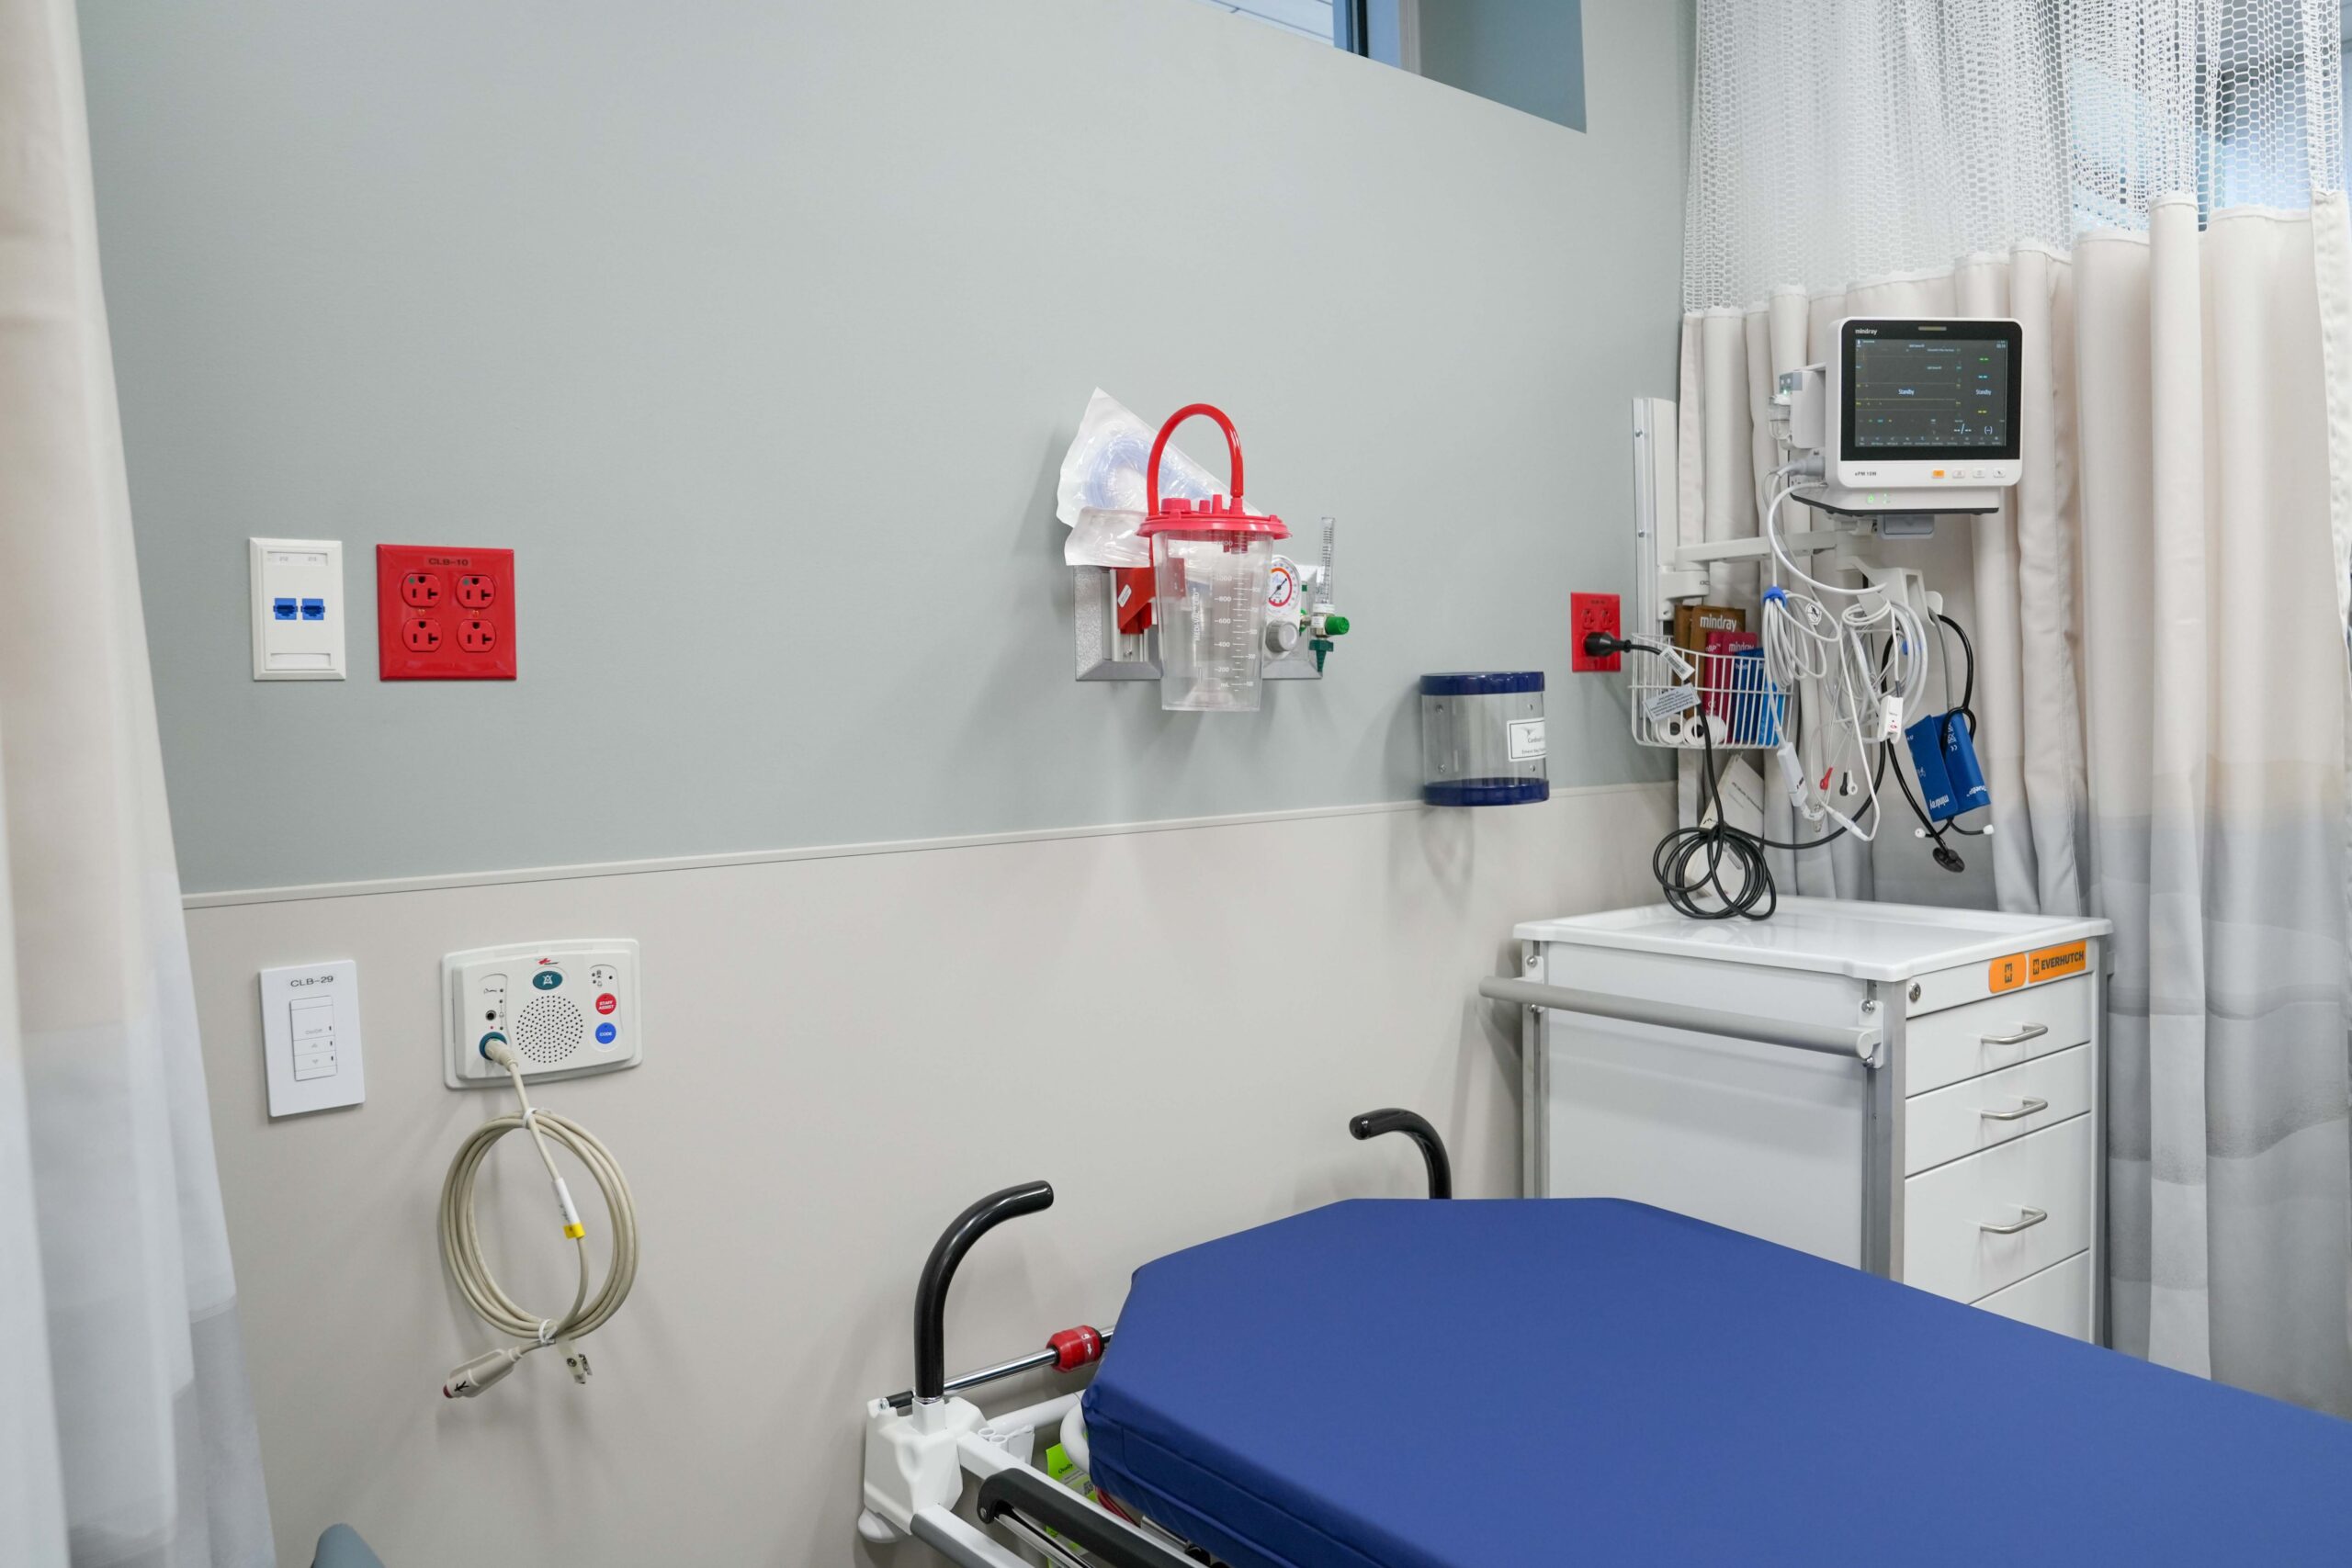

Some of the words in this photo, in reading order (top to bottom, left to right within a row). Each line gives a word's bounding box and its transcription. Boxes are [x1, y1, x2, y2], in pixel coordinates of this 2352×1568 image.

[428, 558, 469, 567] CLB-10
[1700, 614, 1737, 633] mindray
[1929, 795, 1949, 809] mindray
[2041, 951, 2084, 970] EVERHUTCH
[290, 975, 334, 987] CLB-29
